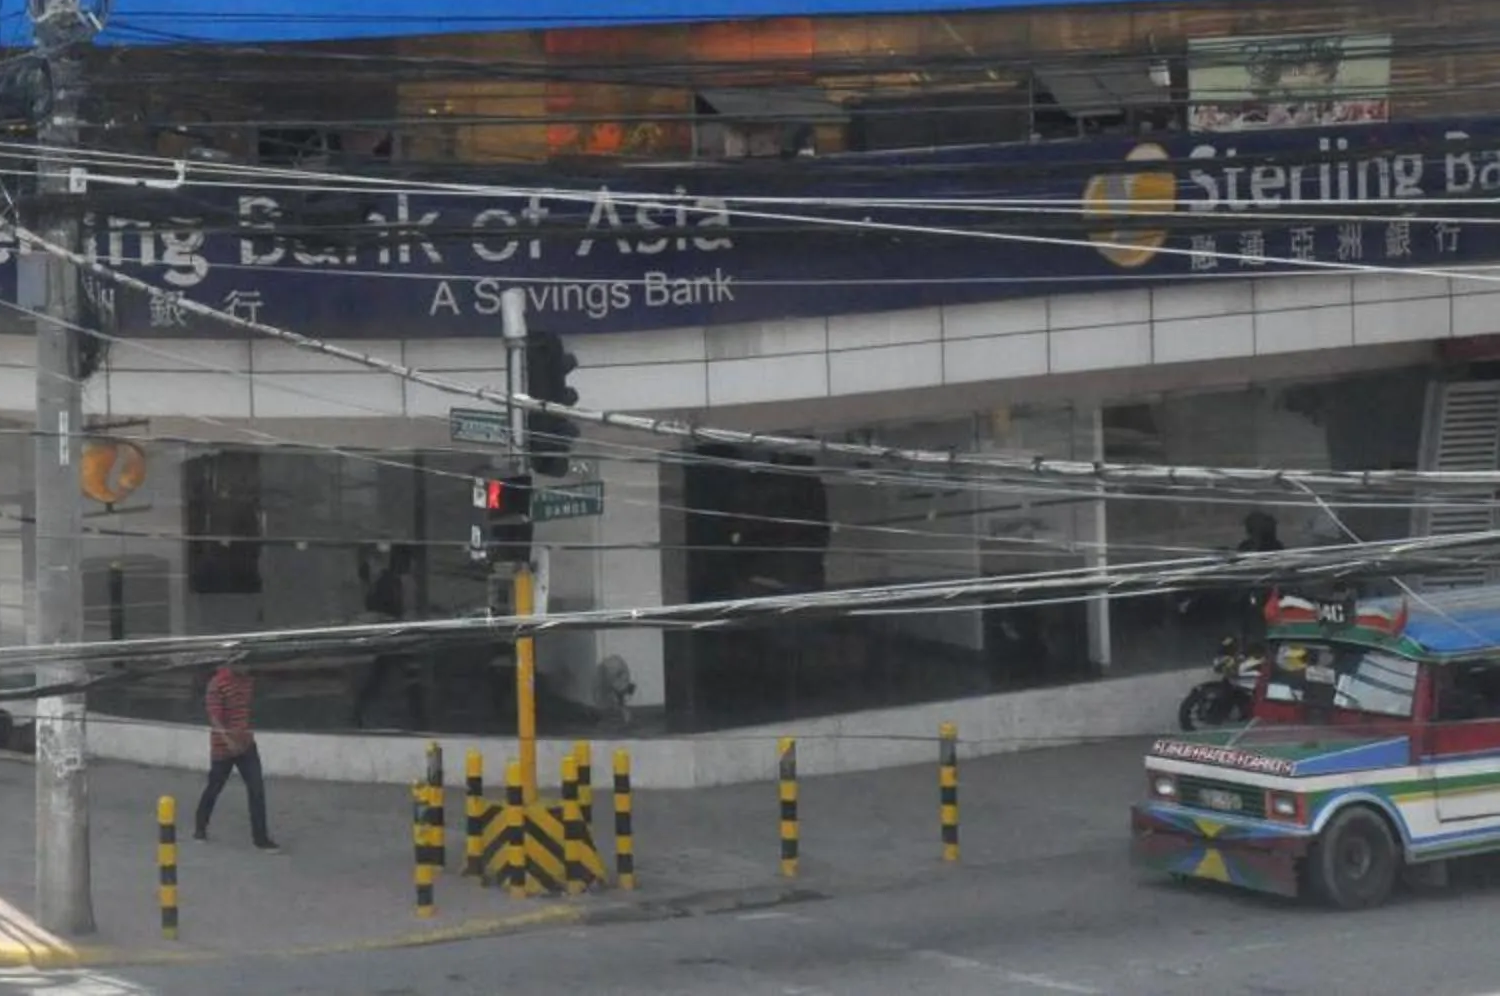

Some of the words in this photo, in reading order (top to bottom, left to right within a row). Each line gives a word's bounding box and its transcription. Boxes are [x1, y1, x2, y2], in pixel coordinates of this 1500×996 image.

[472, 194, 550, 261] of
[576, 184, 734, 256] Asia
[429, 280, 461, 316] A
[474, 277, 632, 319] Svings
[644, 266, 735, 306] Bank
